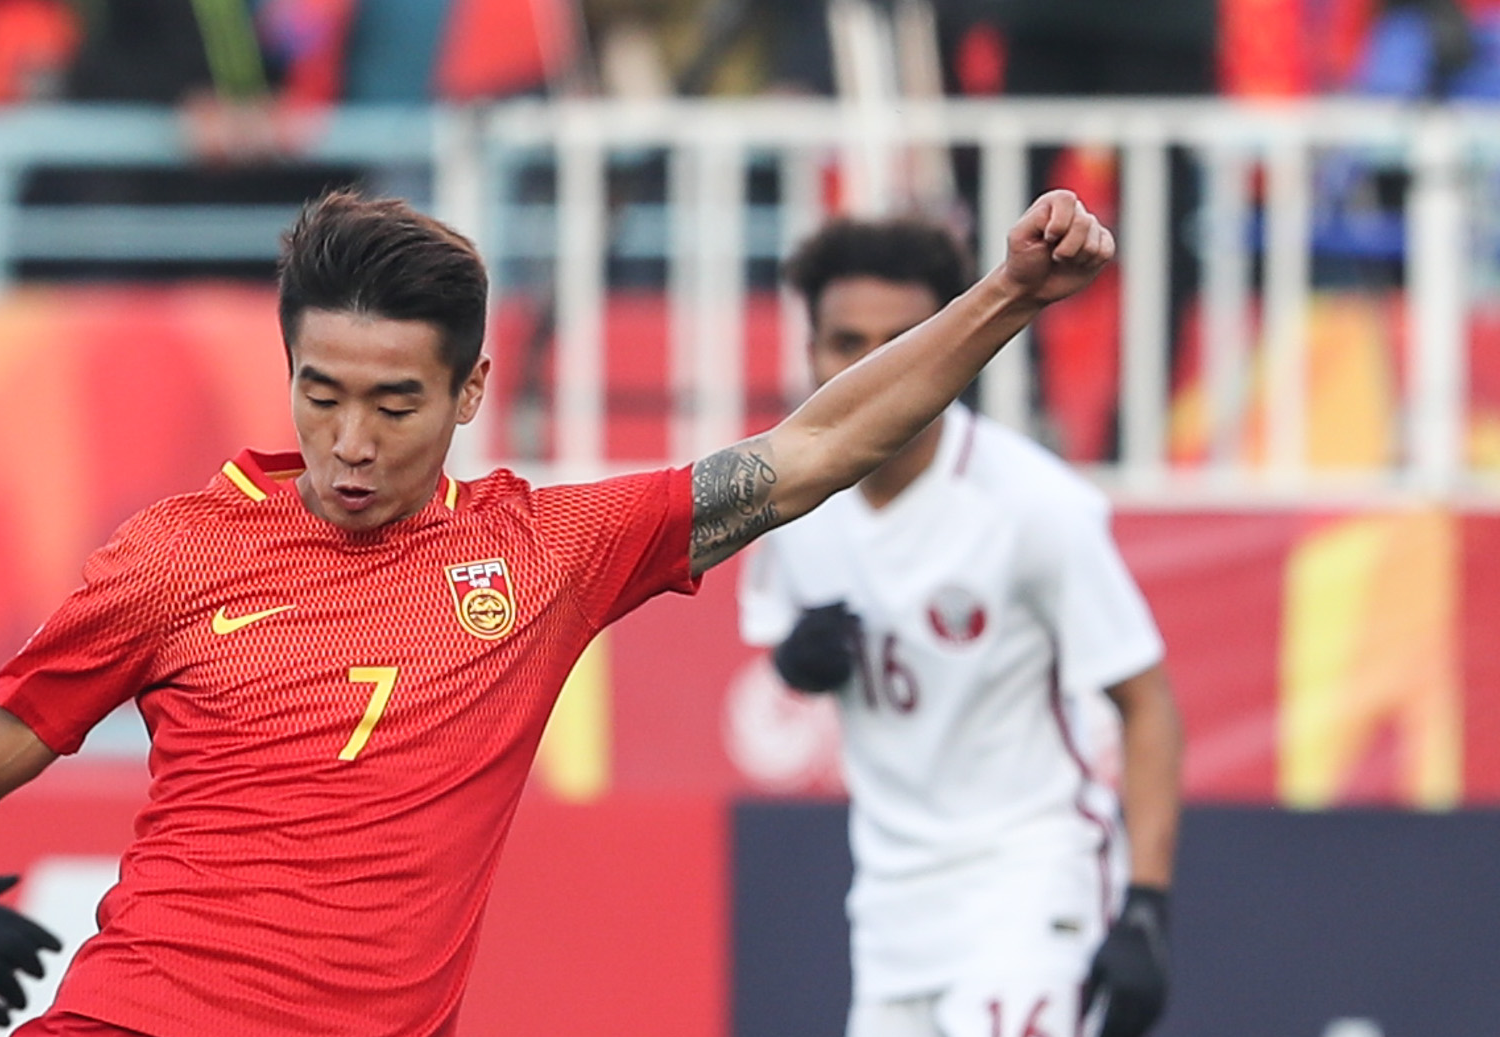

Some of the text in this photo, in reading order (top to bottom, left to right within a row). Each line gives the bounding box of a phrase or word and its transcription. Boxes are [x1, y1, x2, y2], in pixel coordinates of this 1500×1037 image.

[451, 562, 503, 582] CFA
[848, 613, 920, 714] 16
[337, 666, 400, 761] 7
